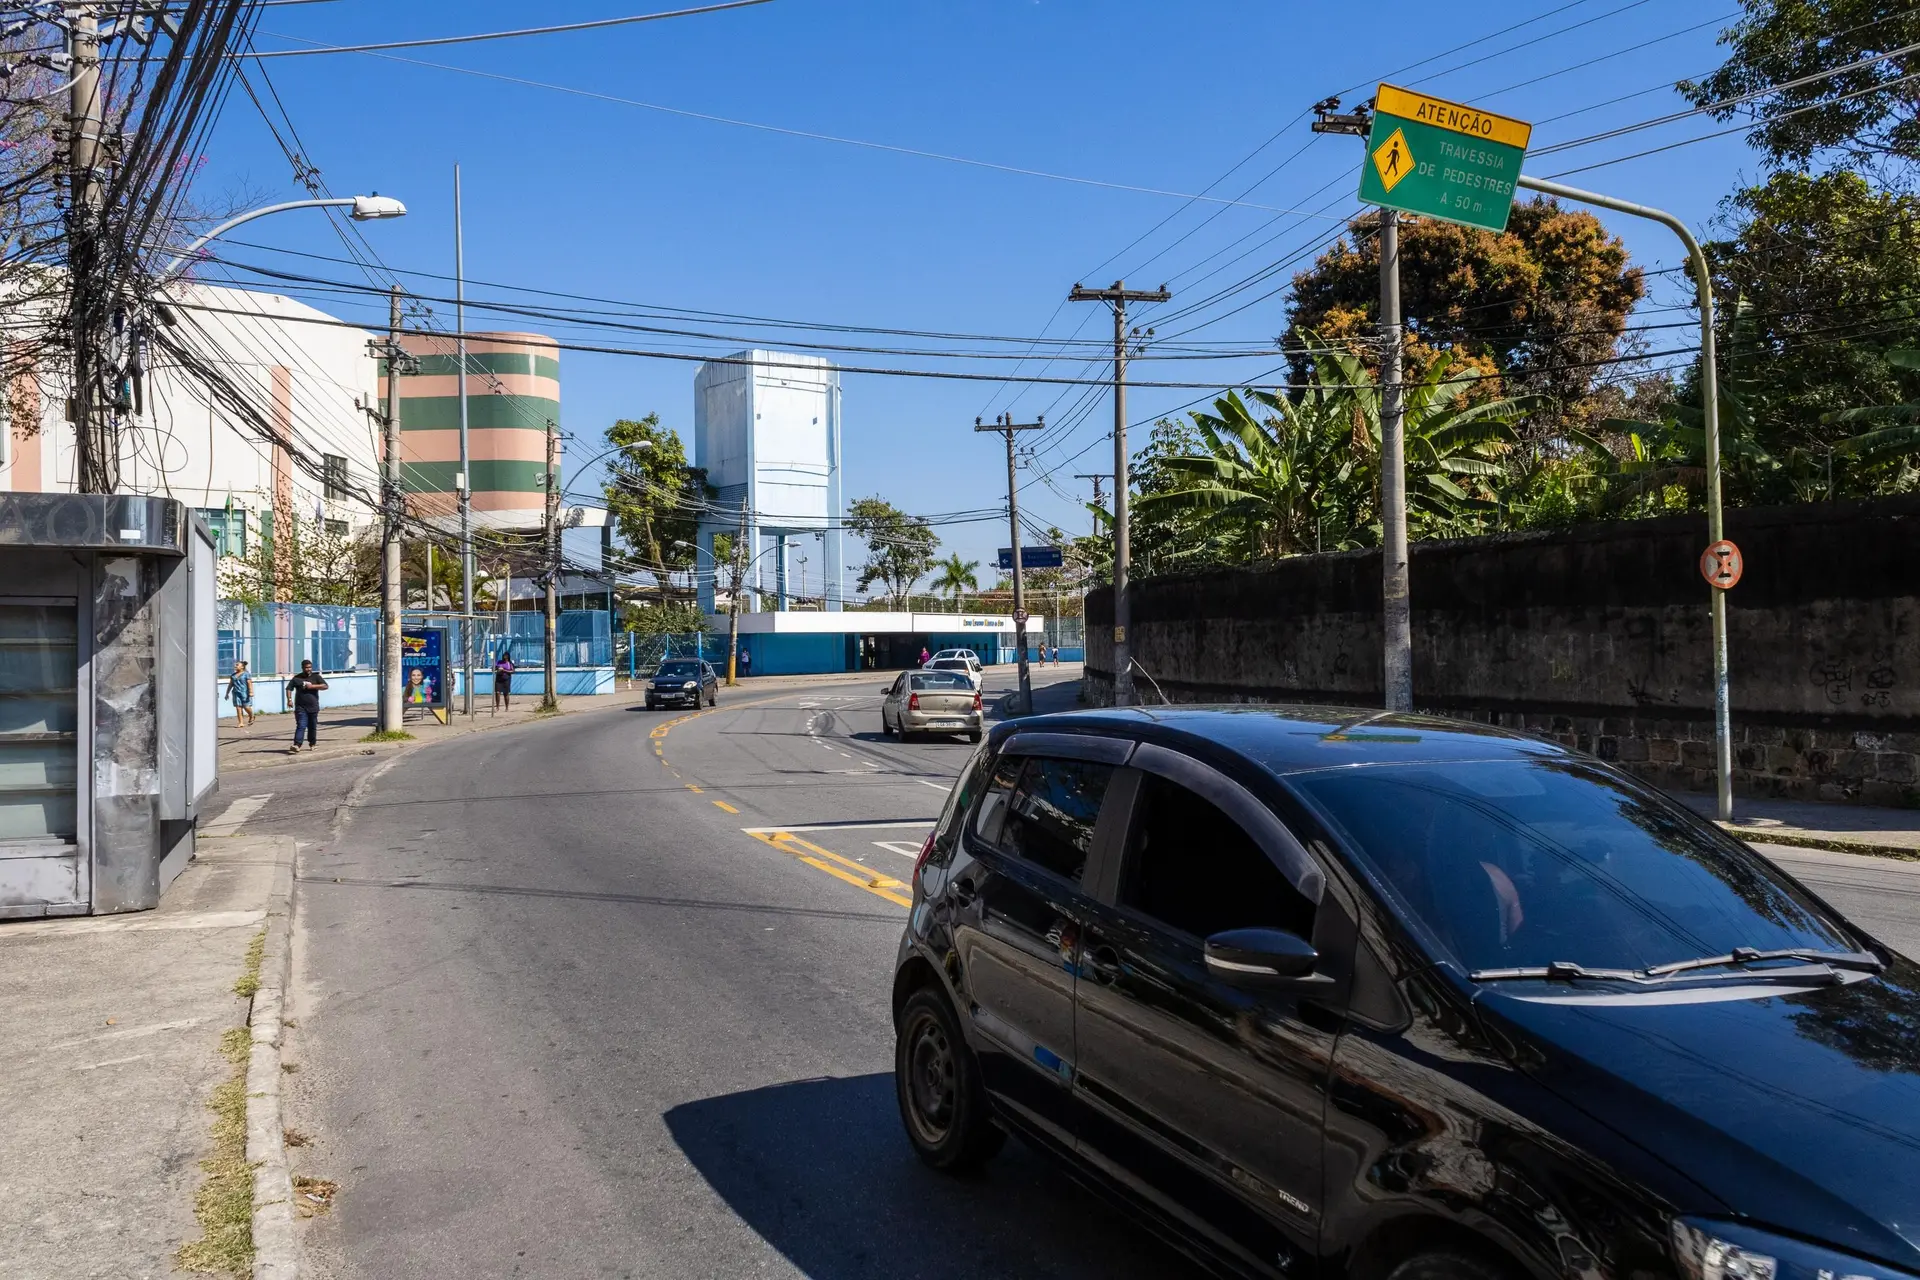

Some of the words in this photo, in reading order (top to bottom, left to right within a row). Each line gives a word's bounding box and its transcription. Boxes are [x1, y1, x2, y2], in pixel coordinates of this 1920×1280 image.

[1416, 102, 1492, 135] ATENÇÃO
[1439, 141, 1504, 169] TRAVESSIA
[1418, 161, 1436, 177] DE
[1443, 168, 1512, 196] PEDESTRES
[1454, 195, 1470, 210] 50
[1472, 202, 1482, 213] m
[402, 656, 438, 667] mpeza
[1278, 1189, 1310, 1213] TREND
